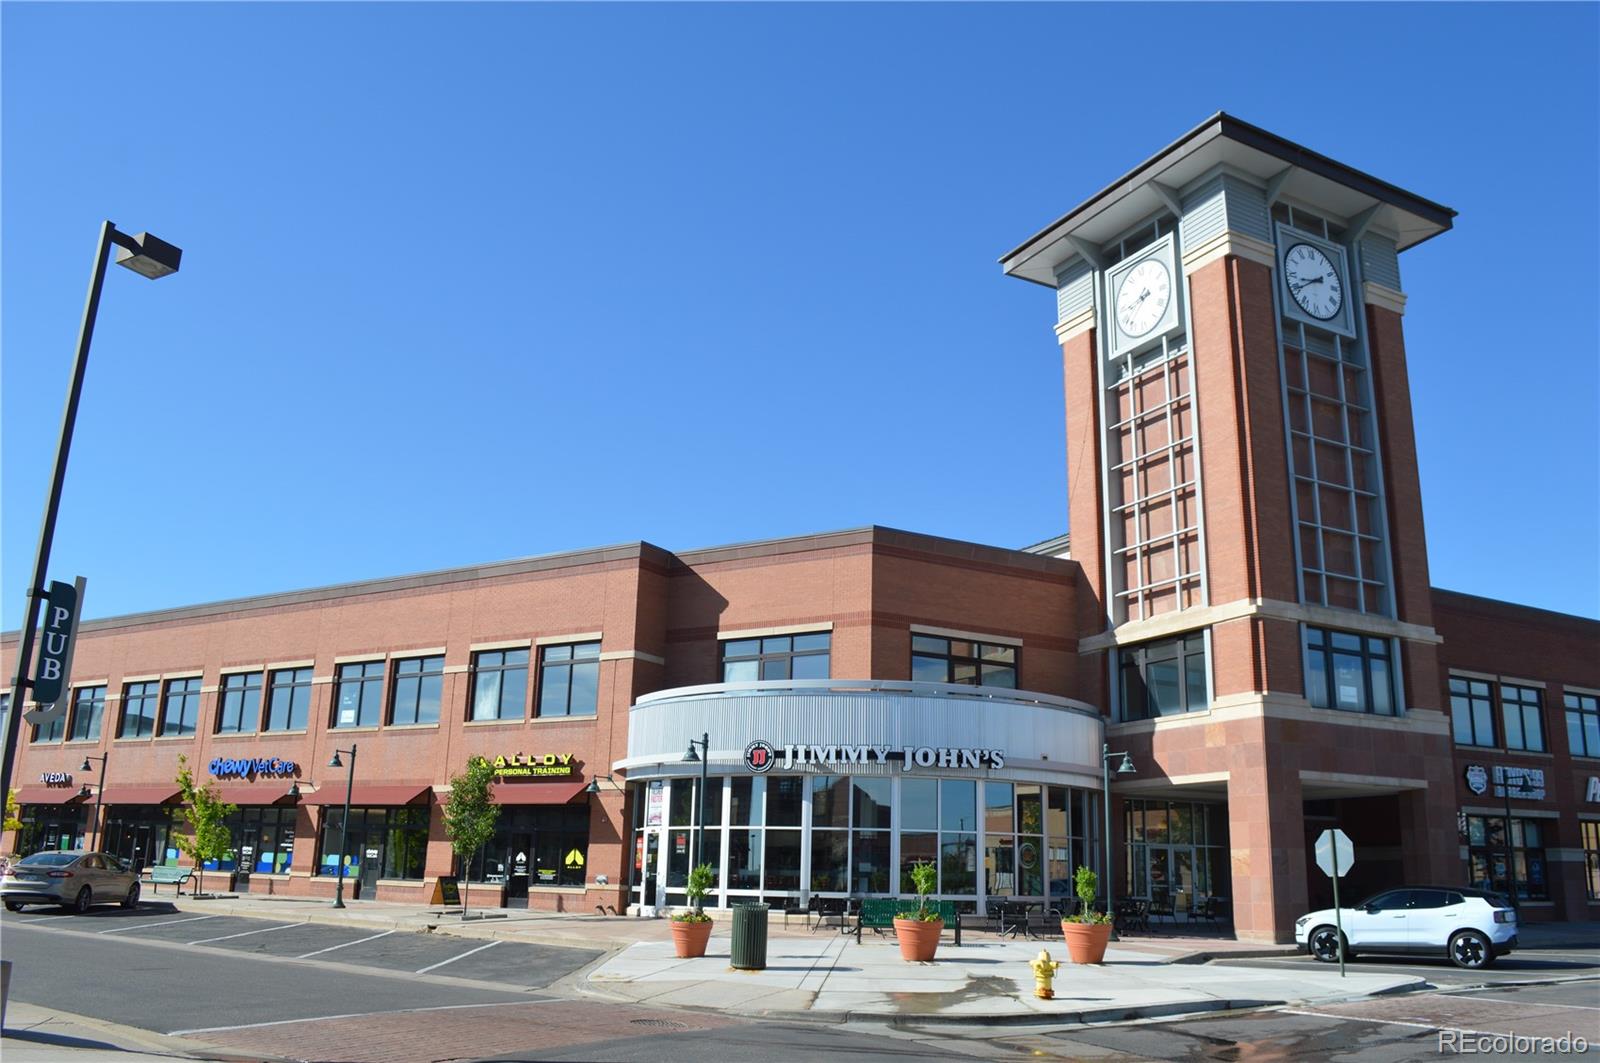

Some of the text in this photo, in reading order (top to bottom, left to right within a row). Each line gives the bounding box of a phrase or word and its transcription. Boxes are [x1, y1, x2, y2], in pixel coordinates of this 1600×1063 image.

[40, 606, 69, 680] PUB
[494, 753, 572, 766] ALLOY
[783, 744, 1005, 773] JIMMY JOHN'S
[208, 757, 251, 778] chewy
[494, 767, 571, 776] PERSONAL TRAINING
[40, 772, 66, 783] AVEDA
